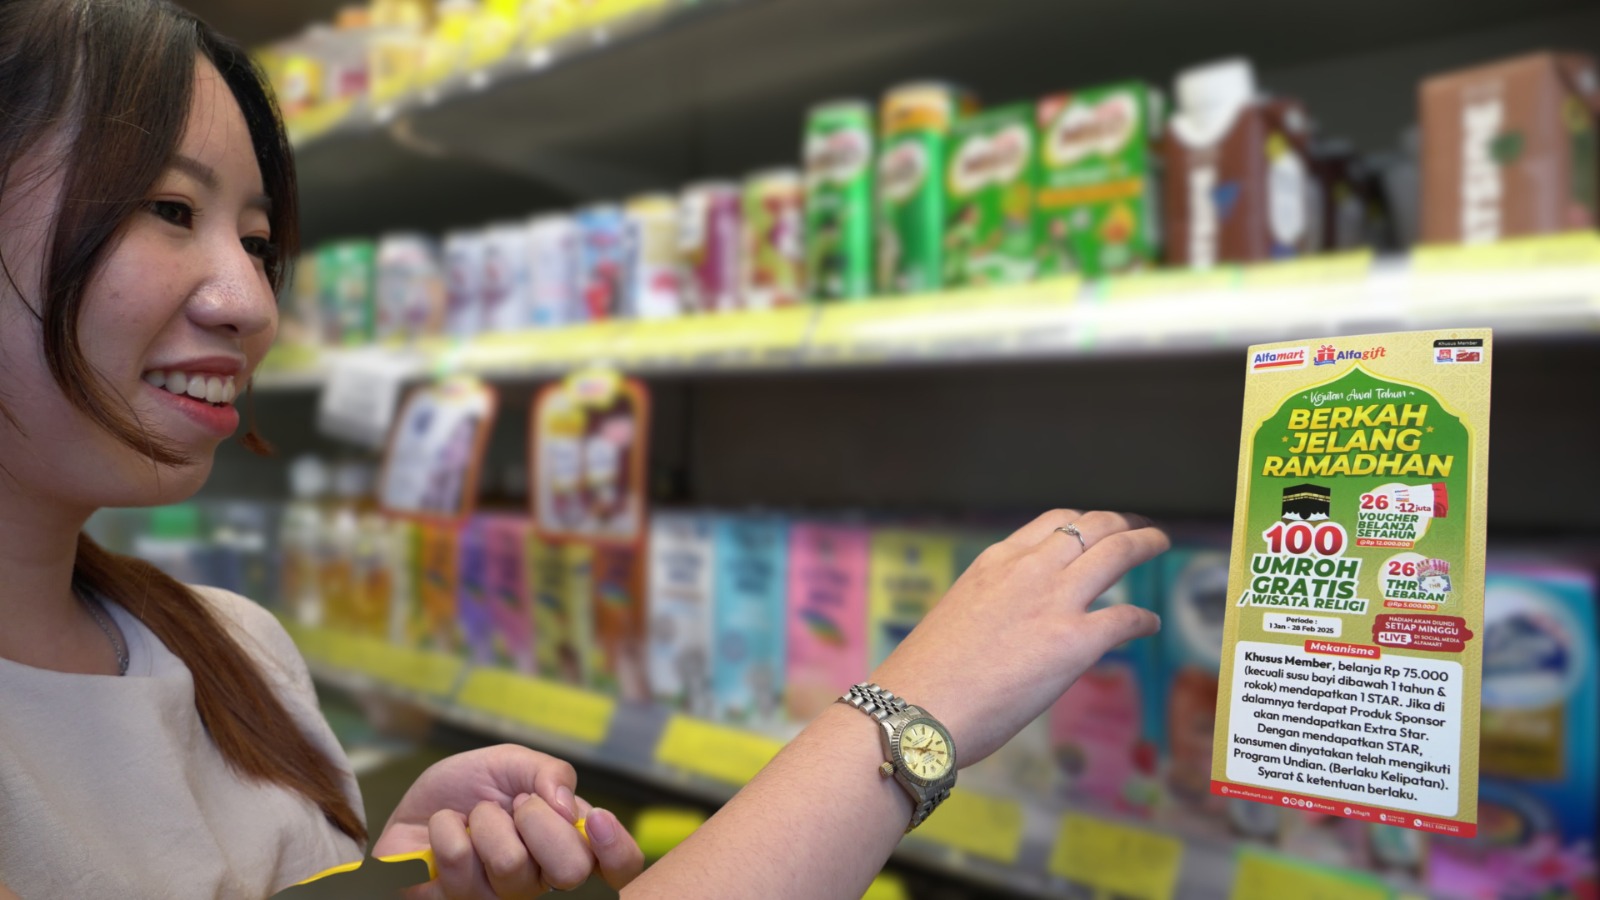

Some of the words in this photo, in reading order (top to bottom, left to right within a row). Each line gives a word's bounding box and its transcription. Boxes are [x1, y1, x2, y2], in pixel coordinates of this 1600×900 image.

[1254, 349, 1304, 363] Alfamart
[1336, 346, 1387, 360] Alfagift
[1310, 391, 1344, 407] Kejutan
[1346, 388, 1372, 401] Awal
[1375, 388, 1406, 400] Tahun
[1287, 403, 1428, 430] BERKAH
[1288, 428, 1423, 454] JELANG
[1261, 453, 1454, 477] RAMADHAN
[1361, 494, 1389, 510] 26
[1357, 521, 1415, 531] BELANJA
[1359, 512, 1419, 523] VOUCHER
[1266, 524, 1343, 556] 100
[1357, 529, 1417, 540] SETAHUN
[1252, 556, 1359, 579] UMROH
[1388, 561, 1415, 577] 26
[1252, 576, 1356, 599] GRATIS
[1386, 579, 1418, 590] THR
[1314, 598, 1366, 612] RELIGI
[1385, 589, 1446, 602] LEBARAN
[1403, 602, 1436, 610] 5.000.000
[1302, 625, 1315, 633] Feb
[1385, 622, 1417, 631] SETIAP
[1418, 625, 1459, 635] MINGGU
[1310, 642, 1375, 656] Mekanisme
[1244, 652, 1283, 664] Khusus
[1284, 655, 1336, 671] Member,
[1338, 661, 1381, 676] belanja
[1384, 665, 1401, 678] Rp
[1403, 667, 1449, 682] 75.000
[1244, 665, 1284, 679] (kecuali
[1286, 671, 1309, 681] susu
[1311, 672, 1336, 686] bayi
[1338, 676, 1389, 690] dibawah
[1391, 681, 1396, 691] 1
[1398, 683, 1435, 696] tahun
[1437, 686, 1447, 697] &
[1244, 680, 1277, 693] rokok)
[1279, 686, 1358, 701] mendapatkan
[1360, 692, 1364, 702] 1
[1367, 693, 1403, 707] STAR.
[1405, 698, 1431, 711] Jika
[1433, 702, 1445, 712] di
[1241, 693, 1295, 709] dalamnya
[1296, 699, 1347, 715] terdapat
[1349, 706, 1392, 720] Produk
[1394, 711, 1447, 727] Sponsor
[1253, 709, 1280, 720] akan
[1282, 714, 1361, 732] mendapatkan
[1364, 723, 1397, 737] Extra
[1399, 727, 1429, 741] Star.
[1257, 723, 1300, 738] Dengan
[1302, 731, 1384, 750] mendapatkan
[1386, 741, 1423, 757] STAR,
[1233, 733, 1287, 751] konsumen
[1289, 742, 1353, 760] dinyatakan
[1356, 752, 1386, 765] telah
[1388, 758, 1451, 775] mengikuti
[1233, 748, 1281, 764] Program
[1283, 755, 1326, 772] Undian.
[1329, 762, 1378, 779] (Berlaku
[1380, 770, 1449, 791] Kelipatan).
[1257, 766, 1295, 781] Syarat
[1296, 772, 1304, 783] &
[1306, 774, 1365, 792] ketentuan
[1367, 783, 1418, 801] berlaku.
